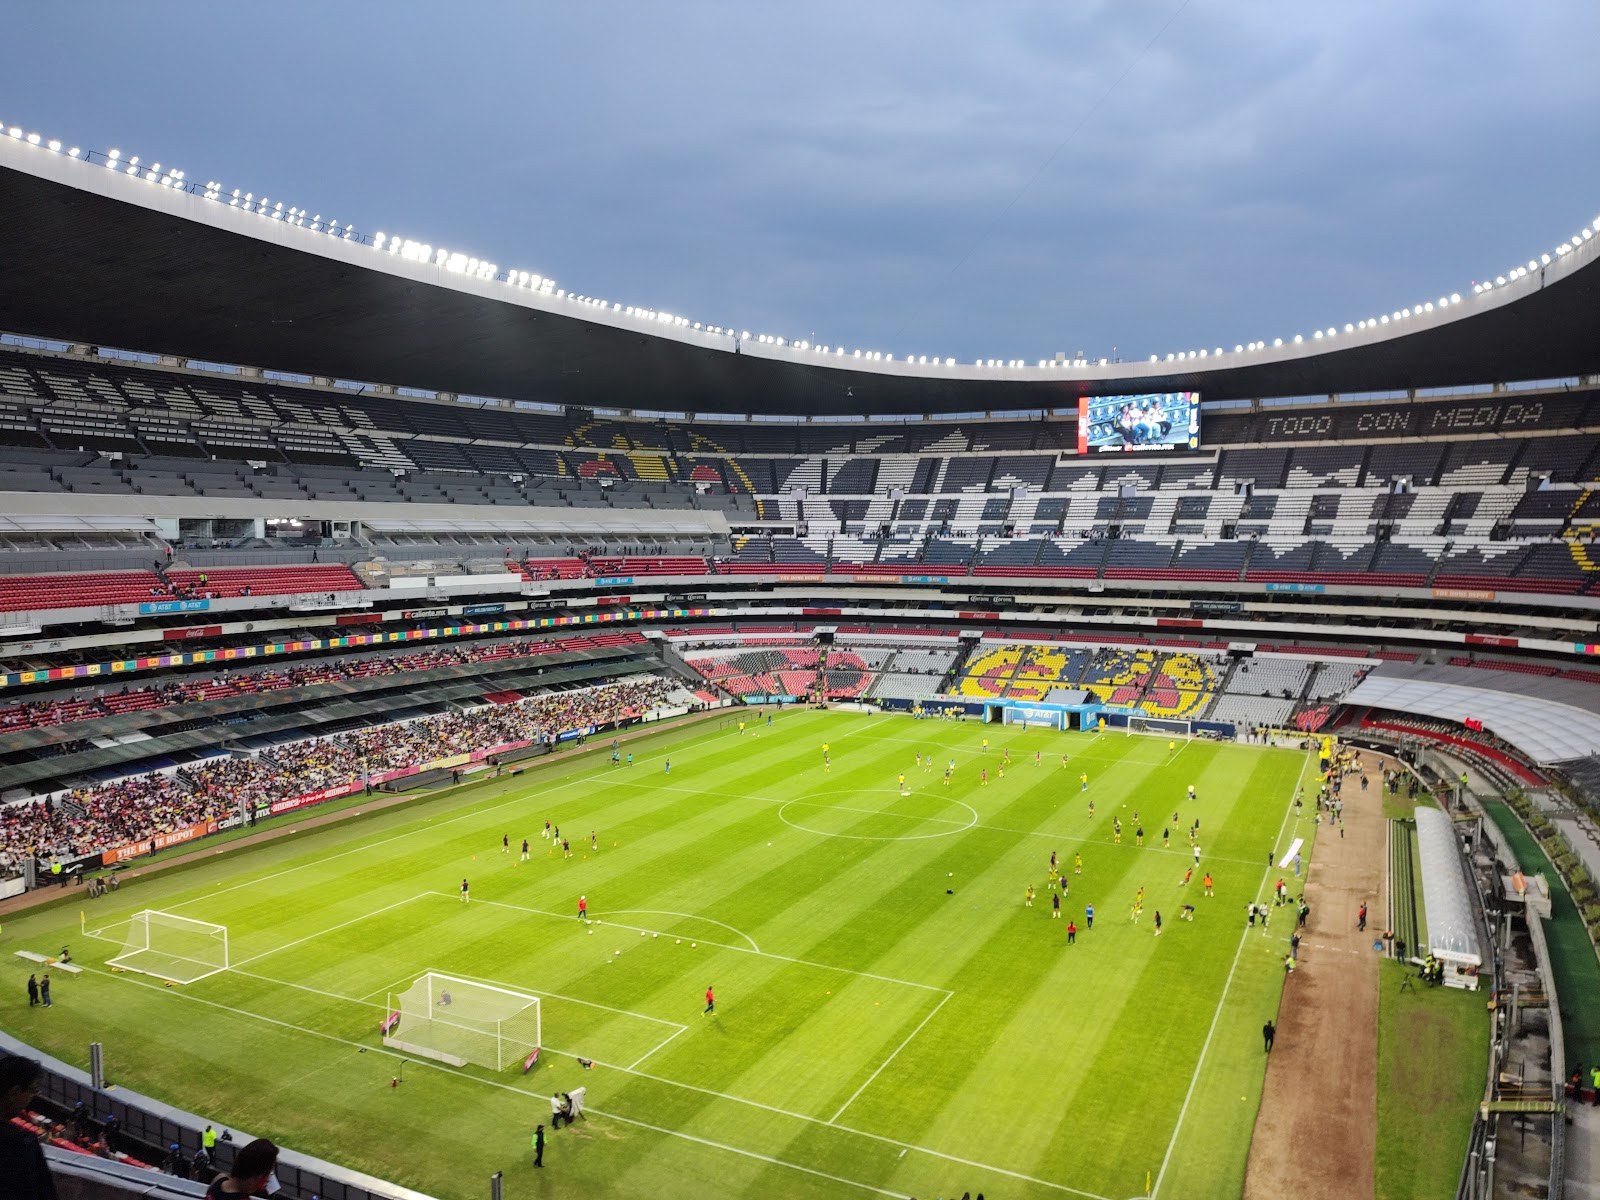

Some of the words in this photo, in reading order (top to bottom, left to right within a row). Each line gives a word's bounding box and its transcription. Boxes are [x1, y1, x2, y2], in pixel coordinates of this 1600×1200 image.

[1268, 415, 1332, 435] TODO
[1356, 411, 1411, 431] CON
[1431, 402, 1544, 428] MEDIDA
[1035, 711, 1053, 719] AT&T
[218, 808, 271, 830] caliet.mx
[116, 845, 137, 858] THE
[166, 828, 195, 844] DEPOT
